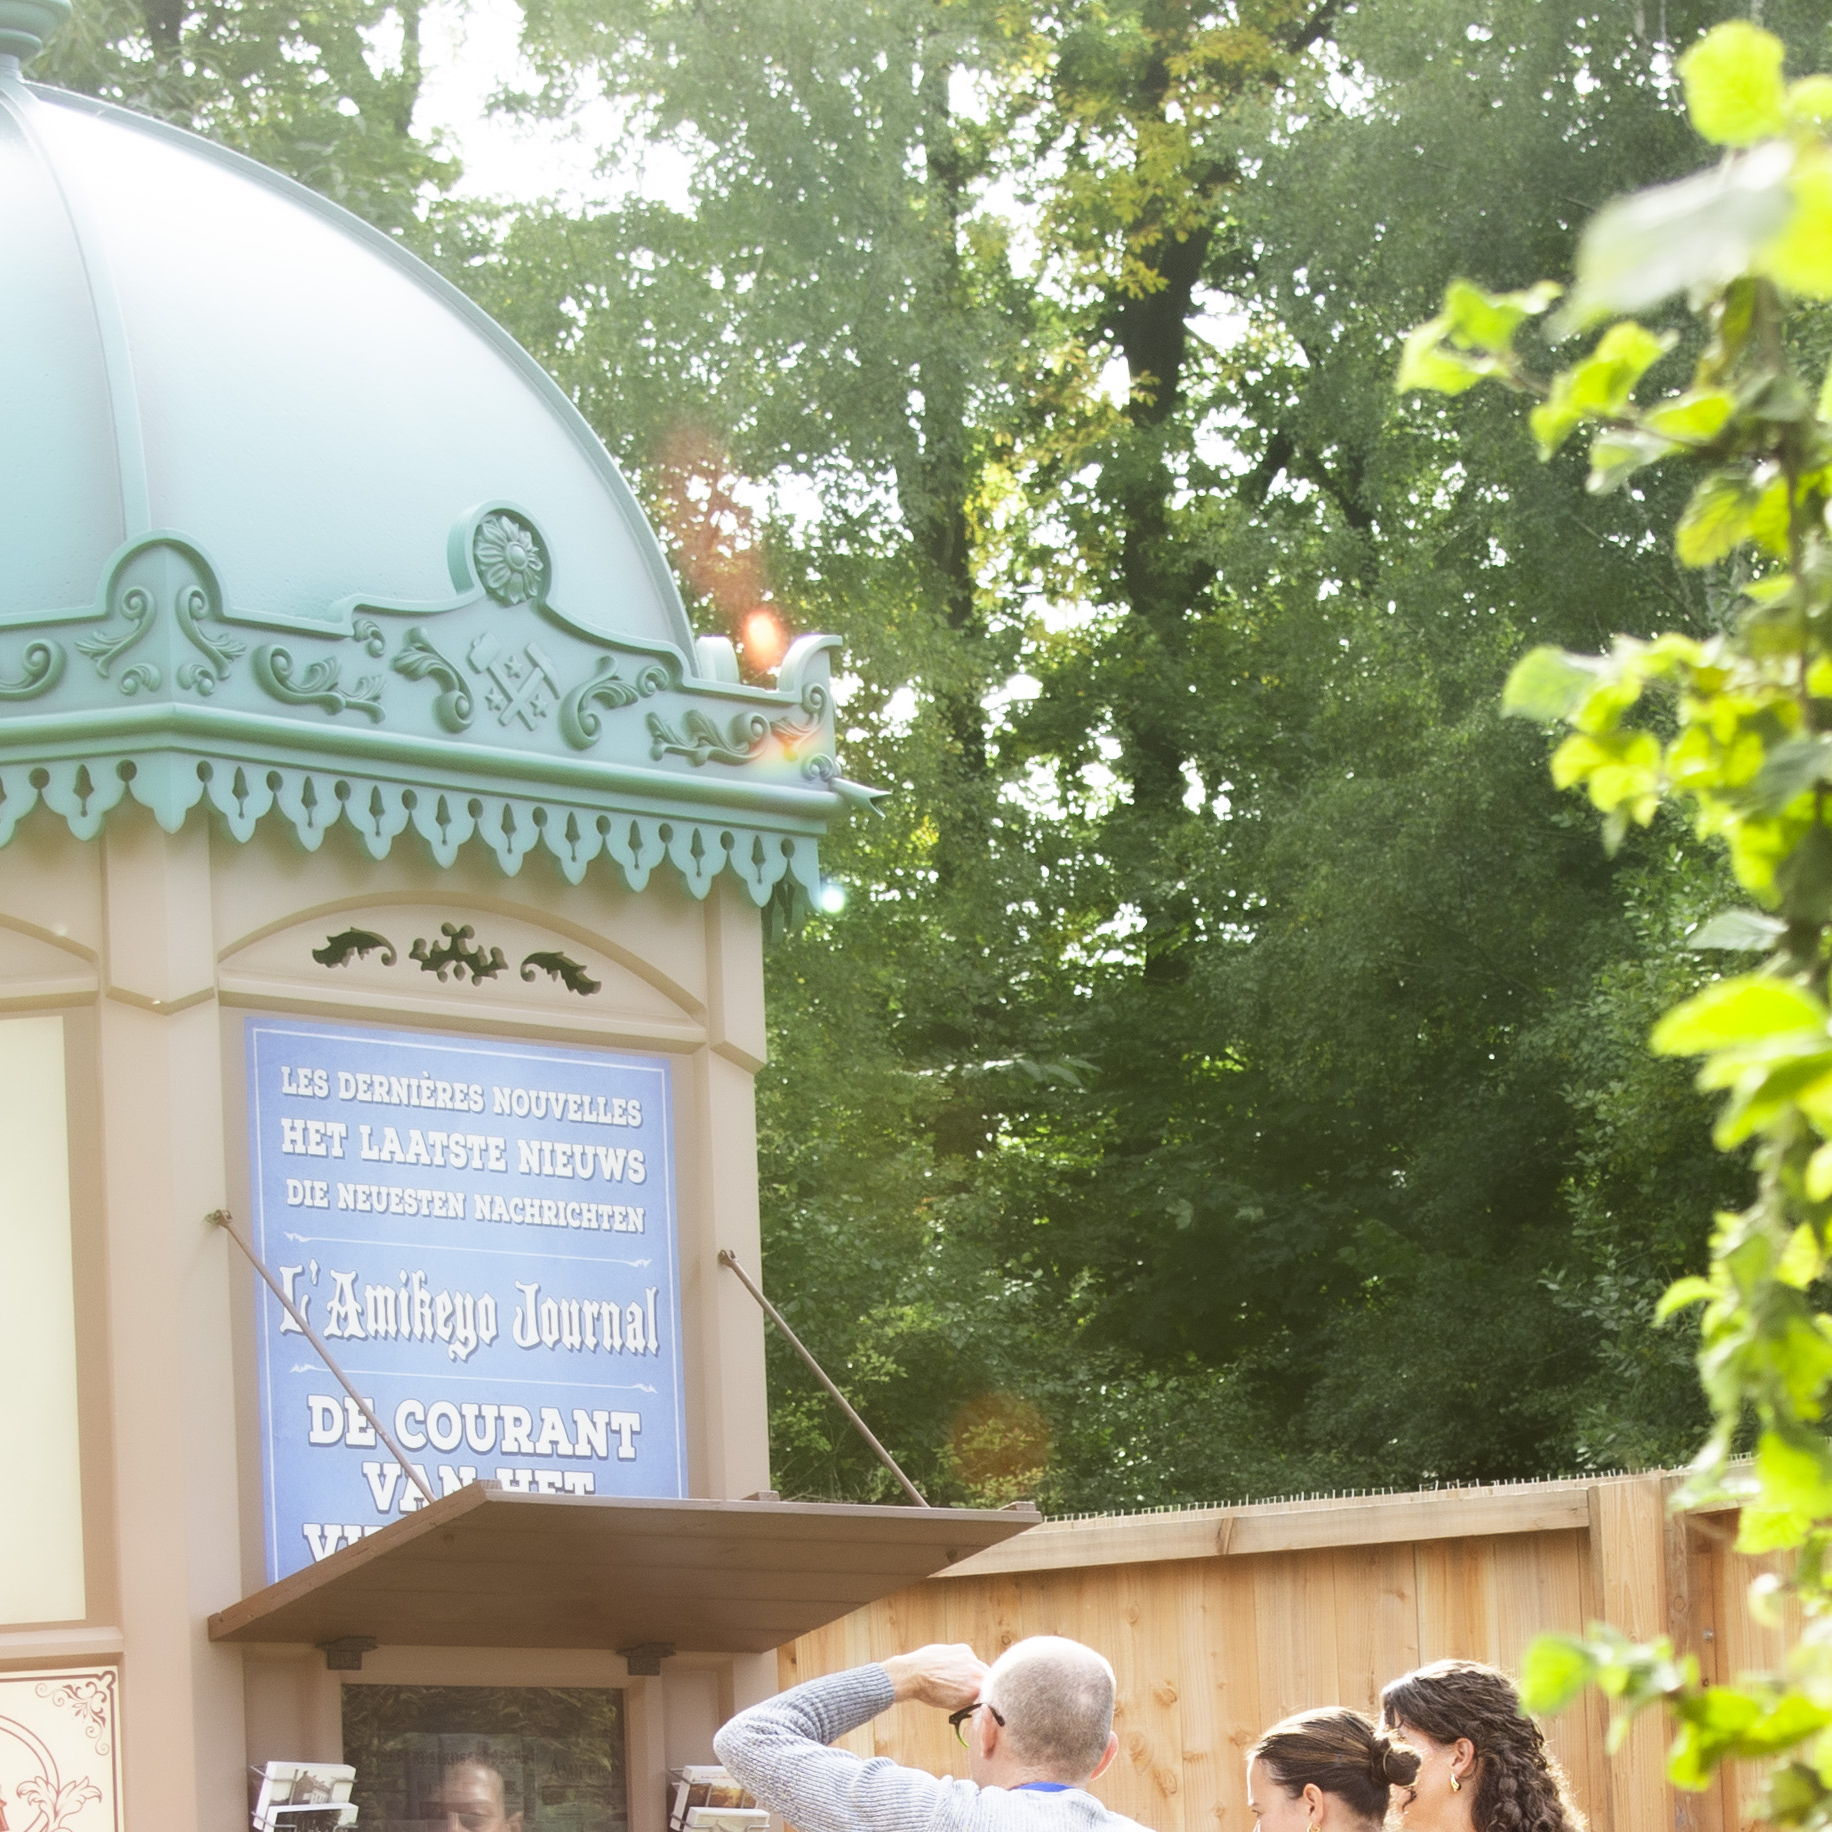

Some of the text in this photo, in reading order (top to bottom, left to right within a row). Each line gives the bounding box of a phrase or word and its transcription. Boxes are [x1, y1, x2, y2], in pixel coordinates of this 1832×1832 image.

[281, 1066, 642, 1128] LES DERNIÈRES NOUVELLES
[281, 1118, 647, 1184] HET LAATSTE NIEUWS
[286, 1178, 646, 1234] DIE NEUESTEN NACHRICHTEN
[513, 1280, 660, 1356] Journal
[307, 1394, 641, 1460] DE COURANT
